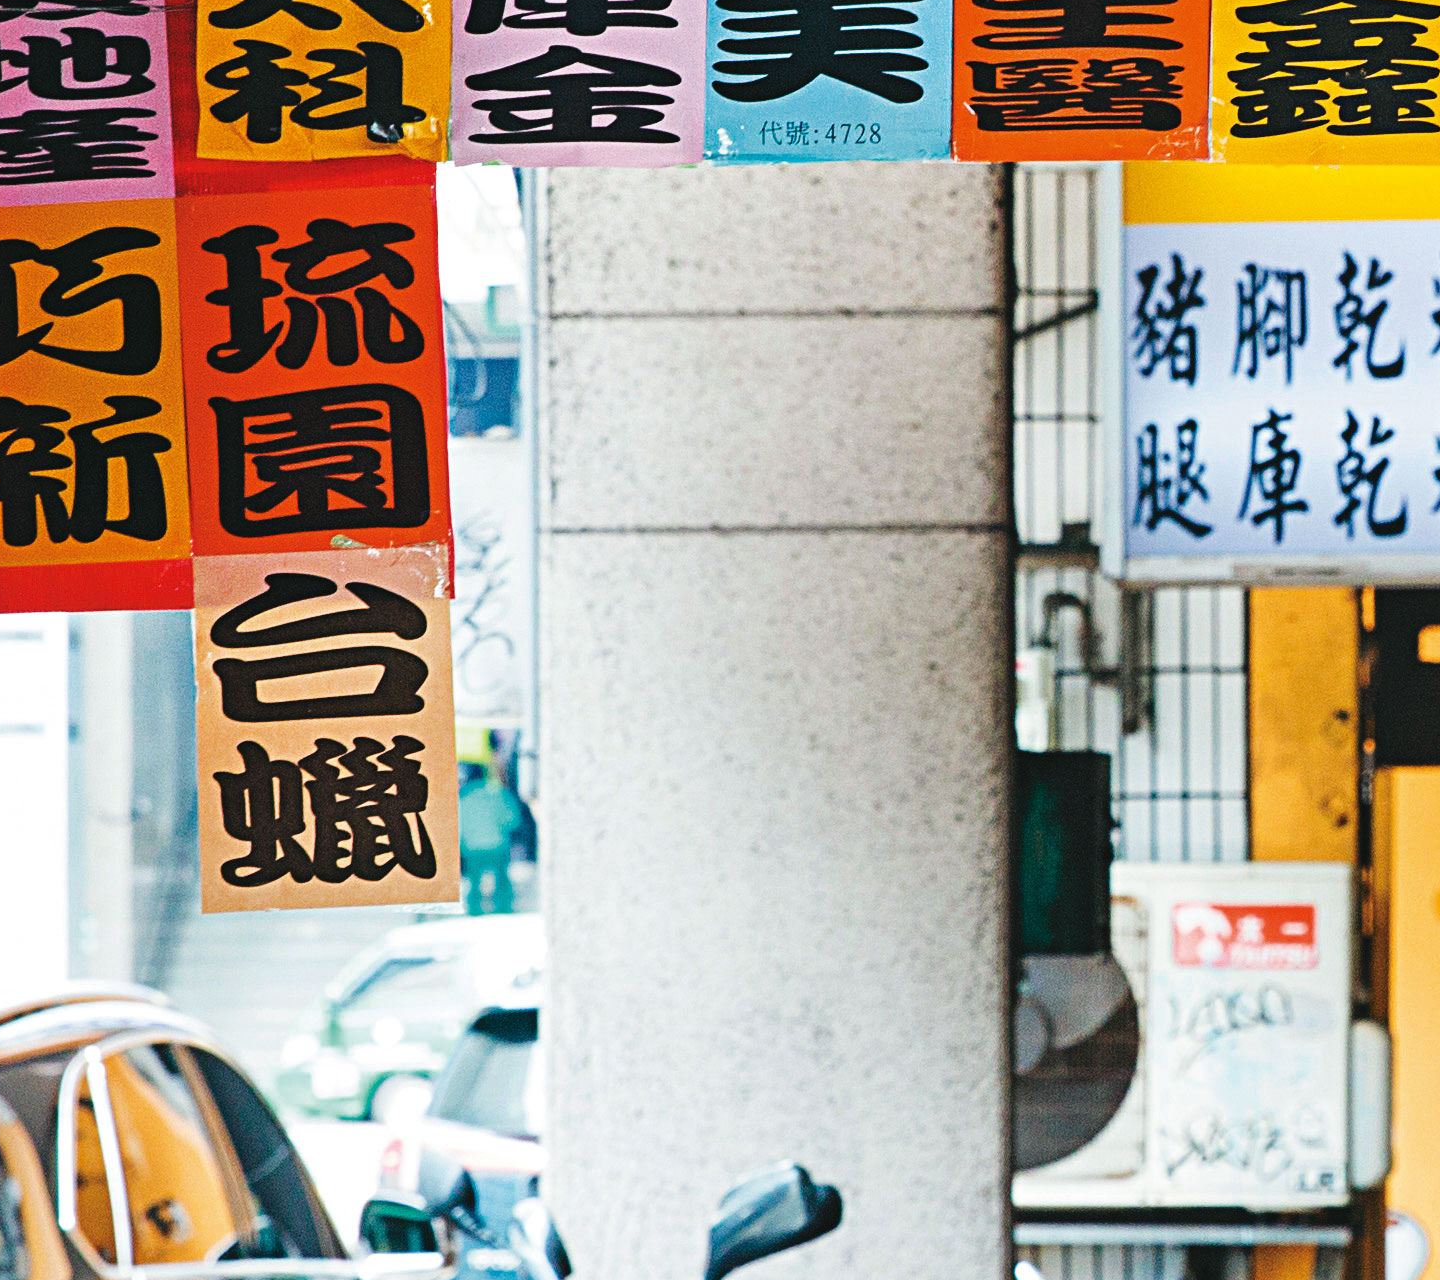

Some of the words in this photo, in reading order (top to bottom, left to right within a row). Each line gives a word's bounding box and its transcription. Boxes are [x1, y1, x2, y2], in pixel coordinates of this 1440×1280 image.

[759, 120, 882, 146] 代號:4728
[202, 219, 430, 538] 琉園
[211, 573, 436, 887] 台蠟
